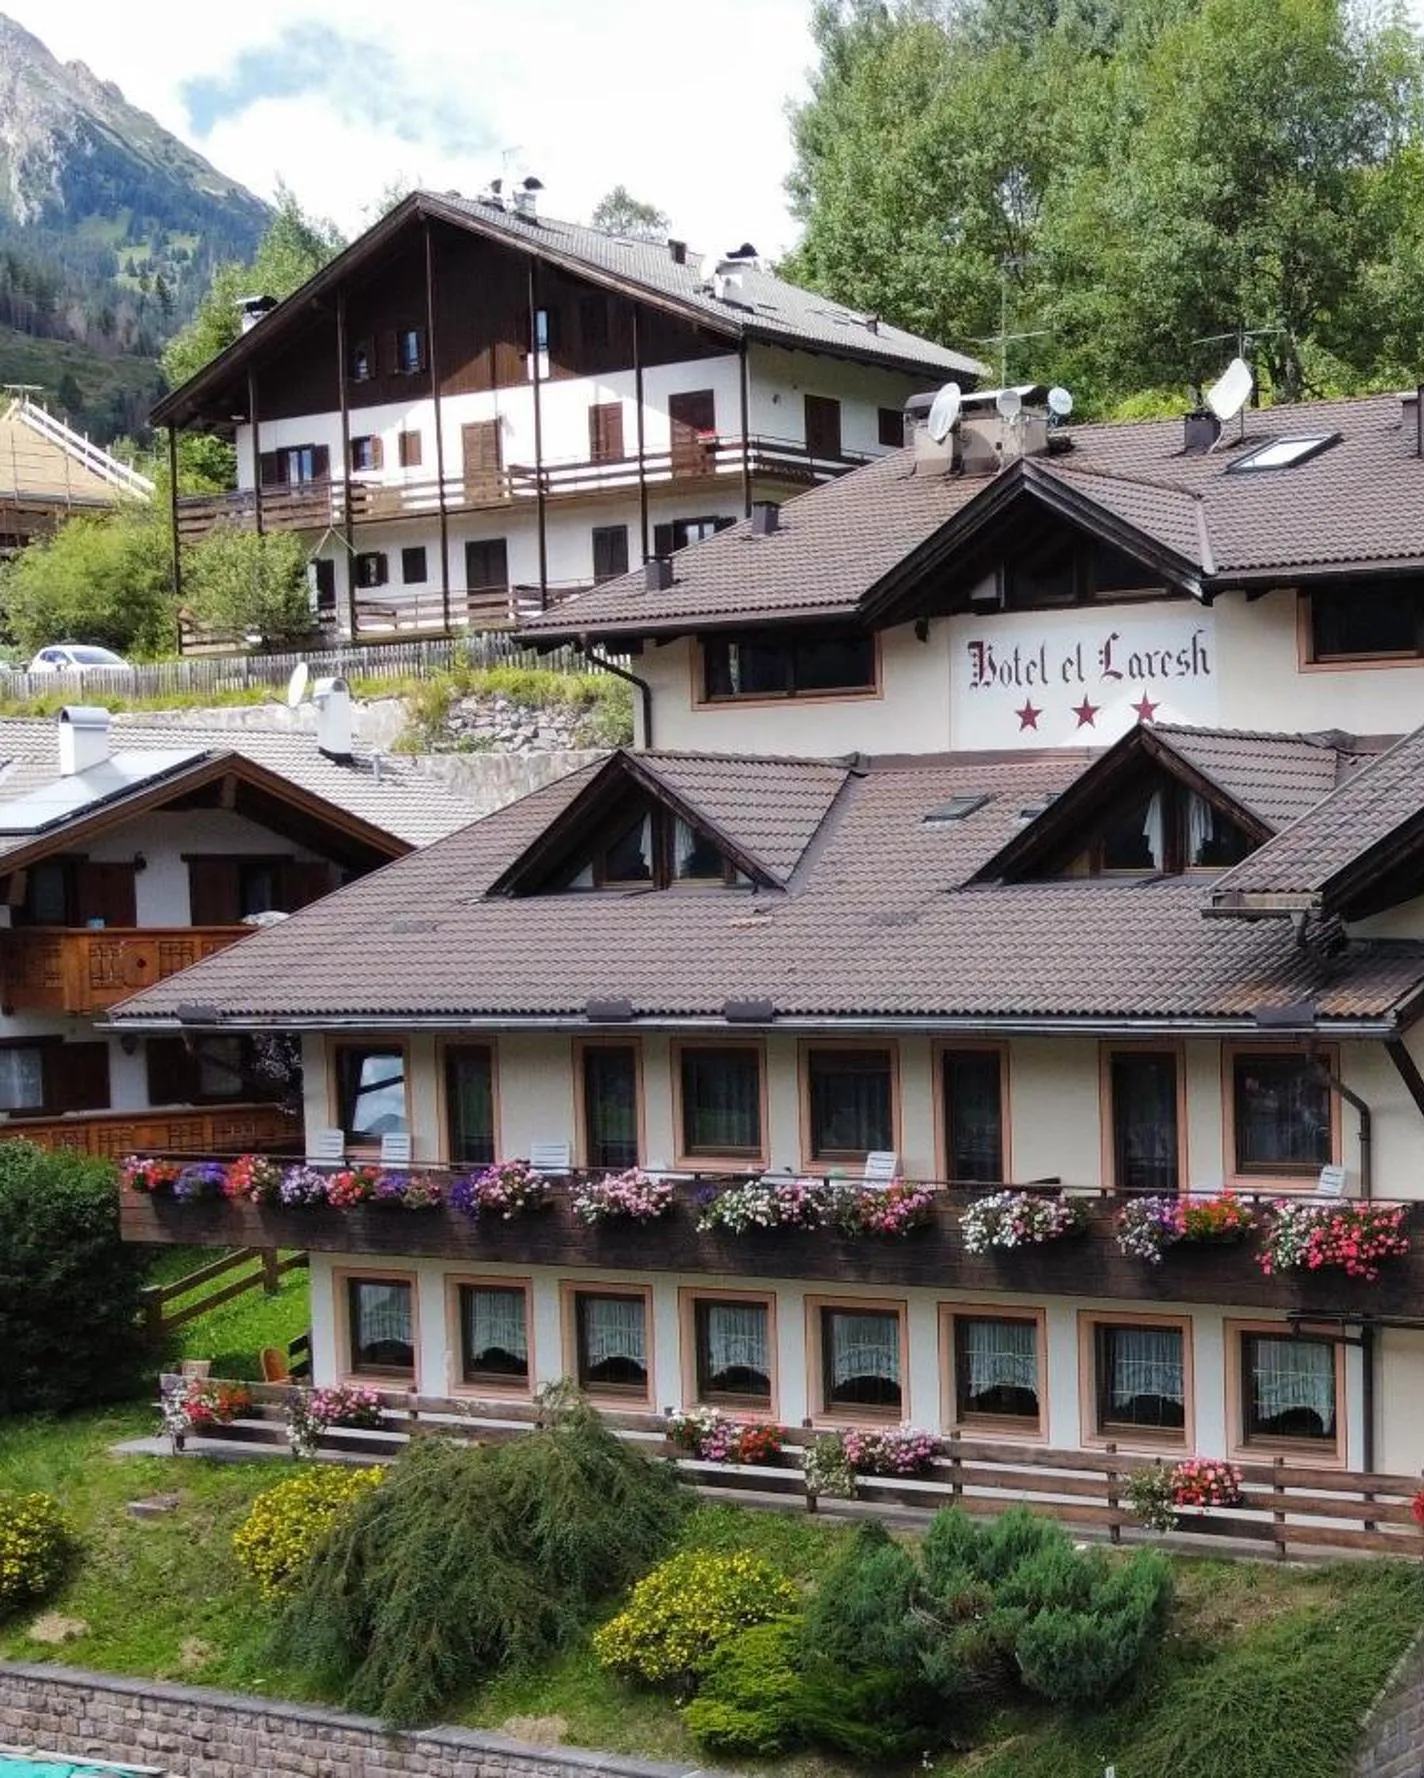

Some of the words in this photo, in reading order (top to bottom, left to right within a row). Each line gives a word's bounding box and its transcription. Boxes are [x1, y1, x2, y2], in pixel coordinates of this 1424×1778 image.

[967, 640, 1049, 688] Hotel
[1061, 641, 1086, 683] el
[1098, 629, 1211, 680] Laresh
